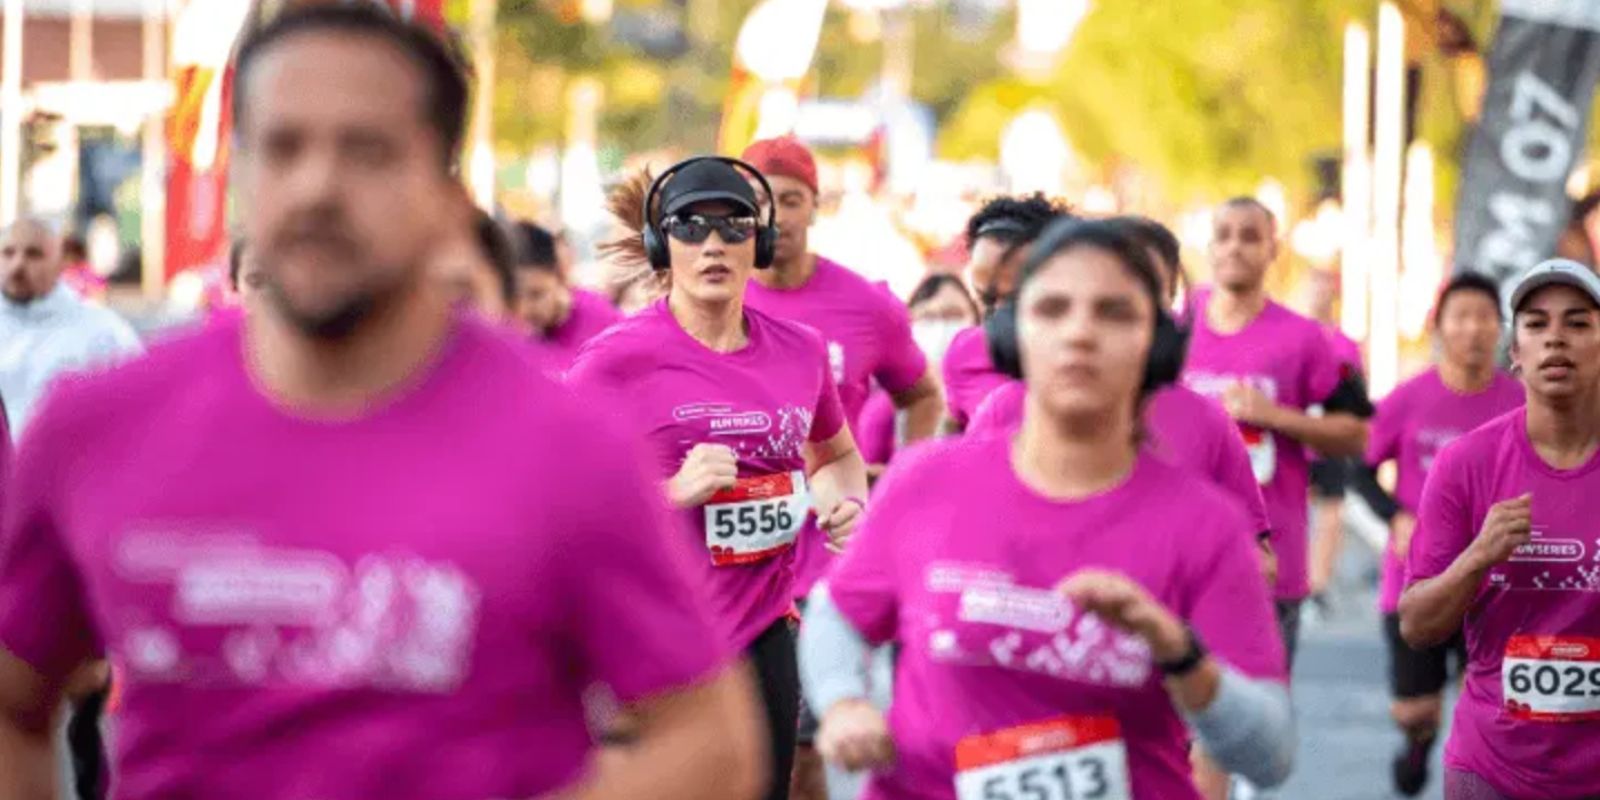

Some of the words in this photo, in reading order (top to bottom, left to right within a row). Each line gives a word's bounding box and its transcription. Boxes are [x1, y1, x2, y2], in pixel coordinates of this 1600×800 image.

[1502, 71, 1579, 182] 07
[715, 500, 792, 539] 5556
[1509, 663, 1600, 696] 6029
[983, 756, 1109, 800] 5513
